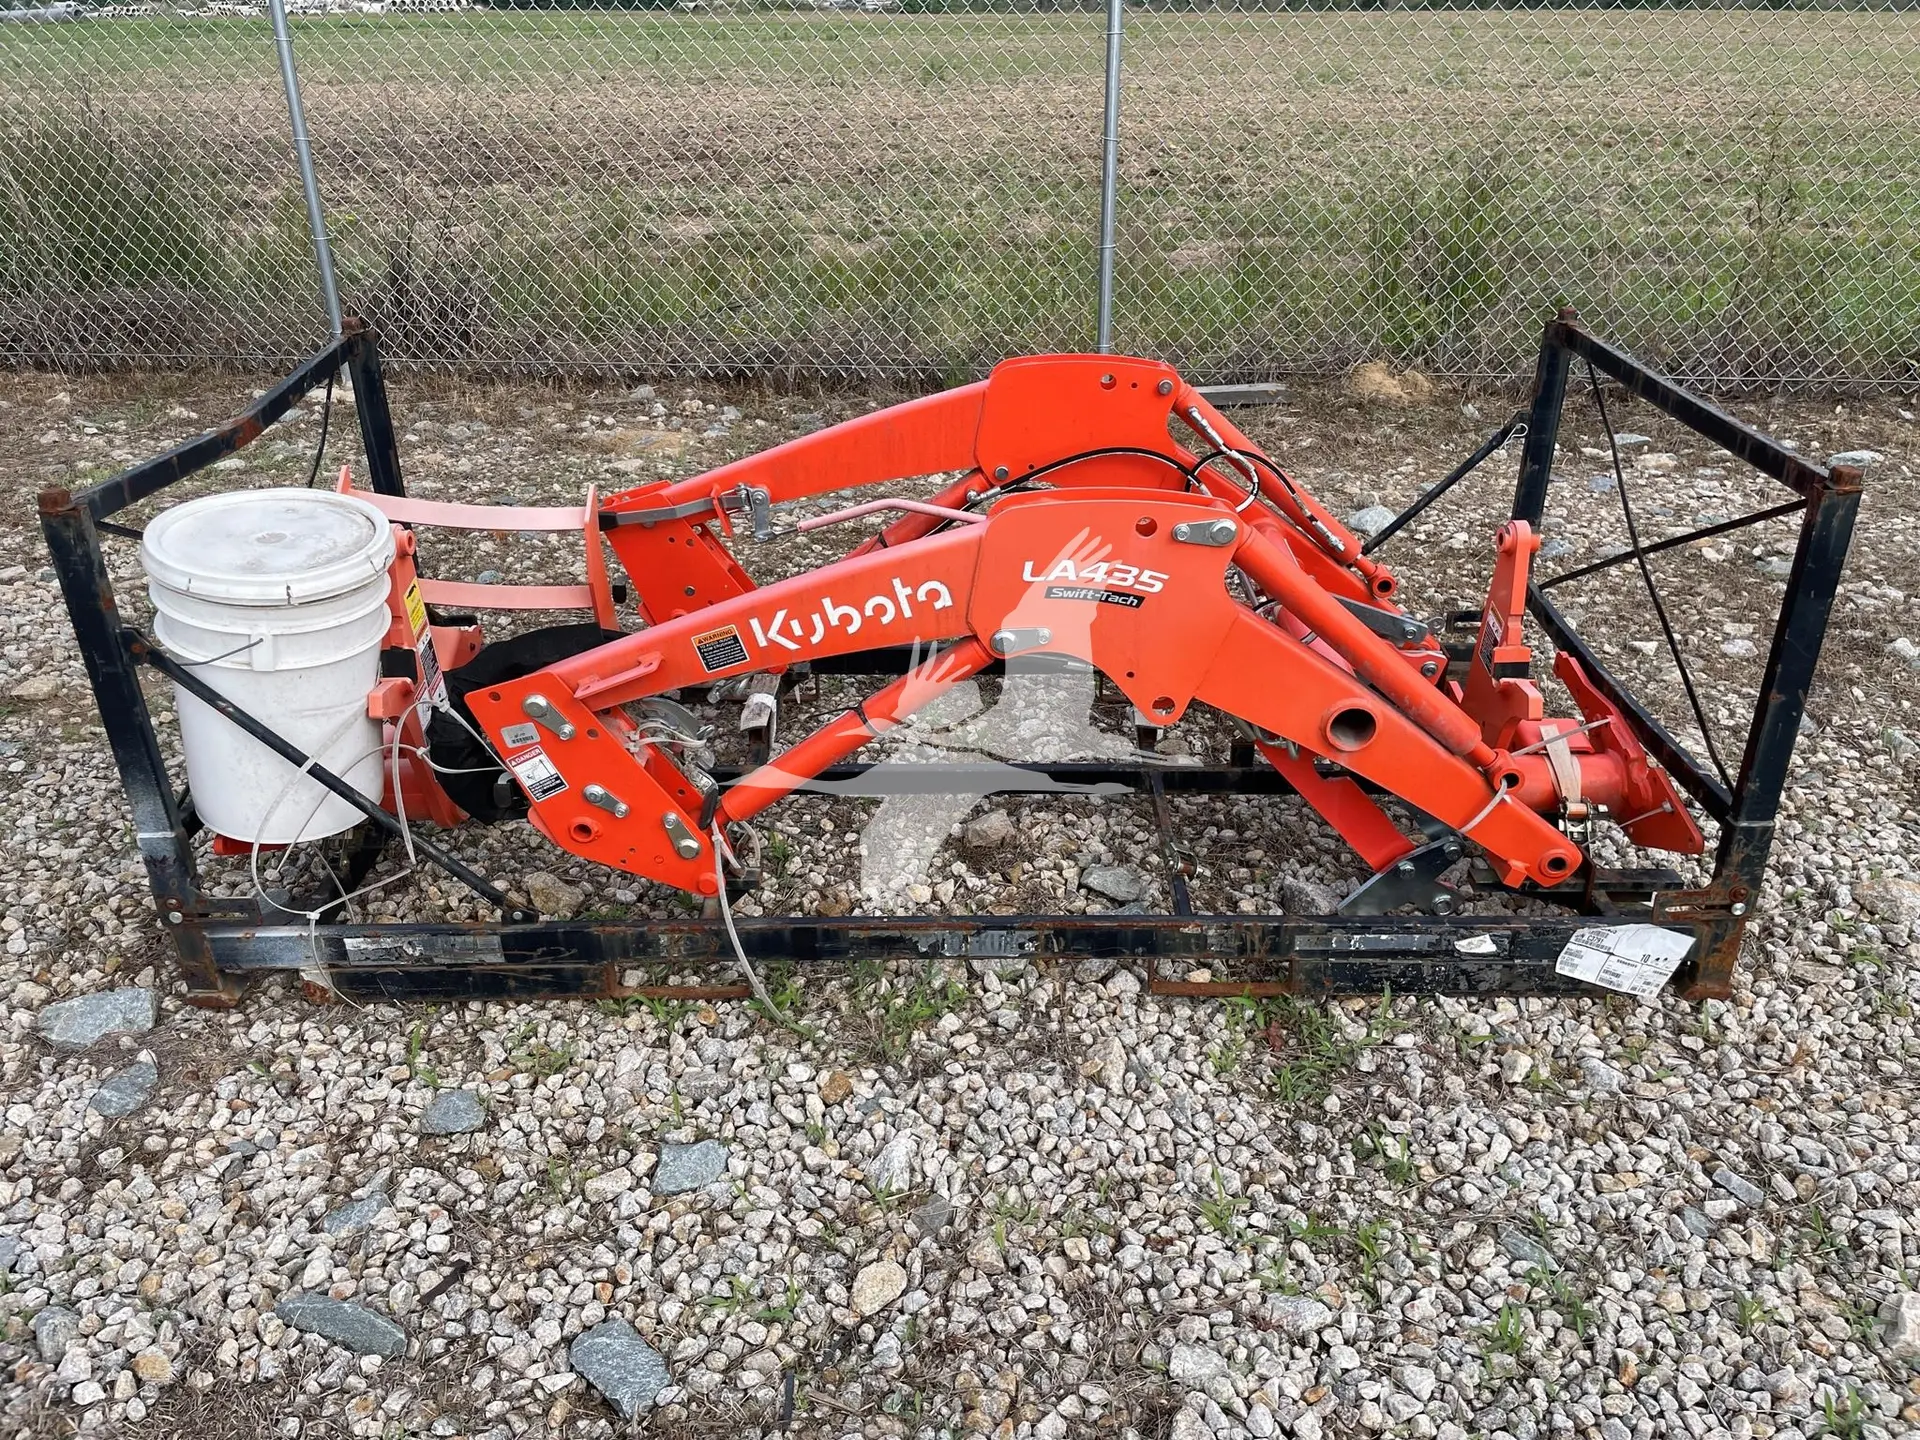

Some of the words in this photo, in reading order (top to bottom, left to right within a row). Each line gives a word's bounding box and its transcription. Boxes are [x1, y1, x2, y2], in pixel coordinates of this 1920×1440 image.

[1022, 559, 1171, 593] LA435
[1049, 587, 1138, 606] Swift-Tach
[749, 577, 953, 651] Kubota
[702, 629, 733, 642] WARNING
[515, 748, 542, 764] DANGER
